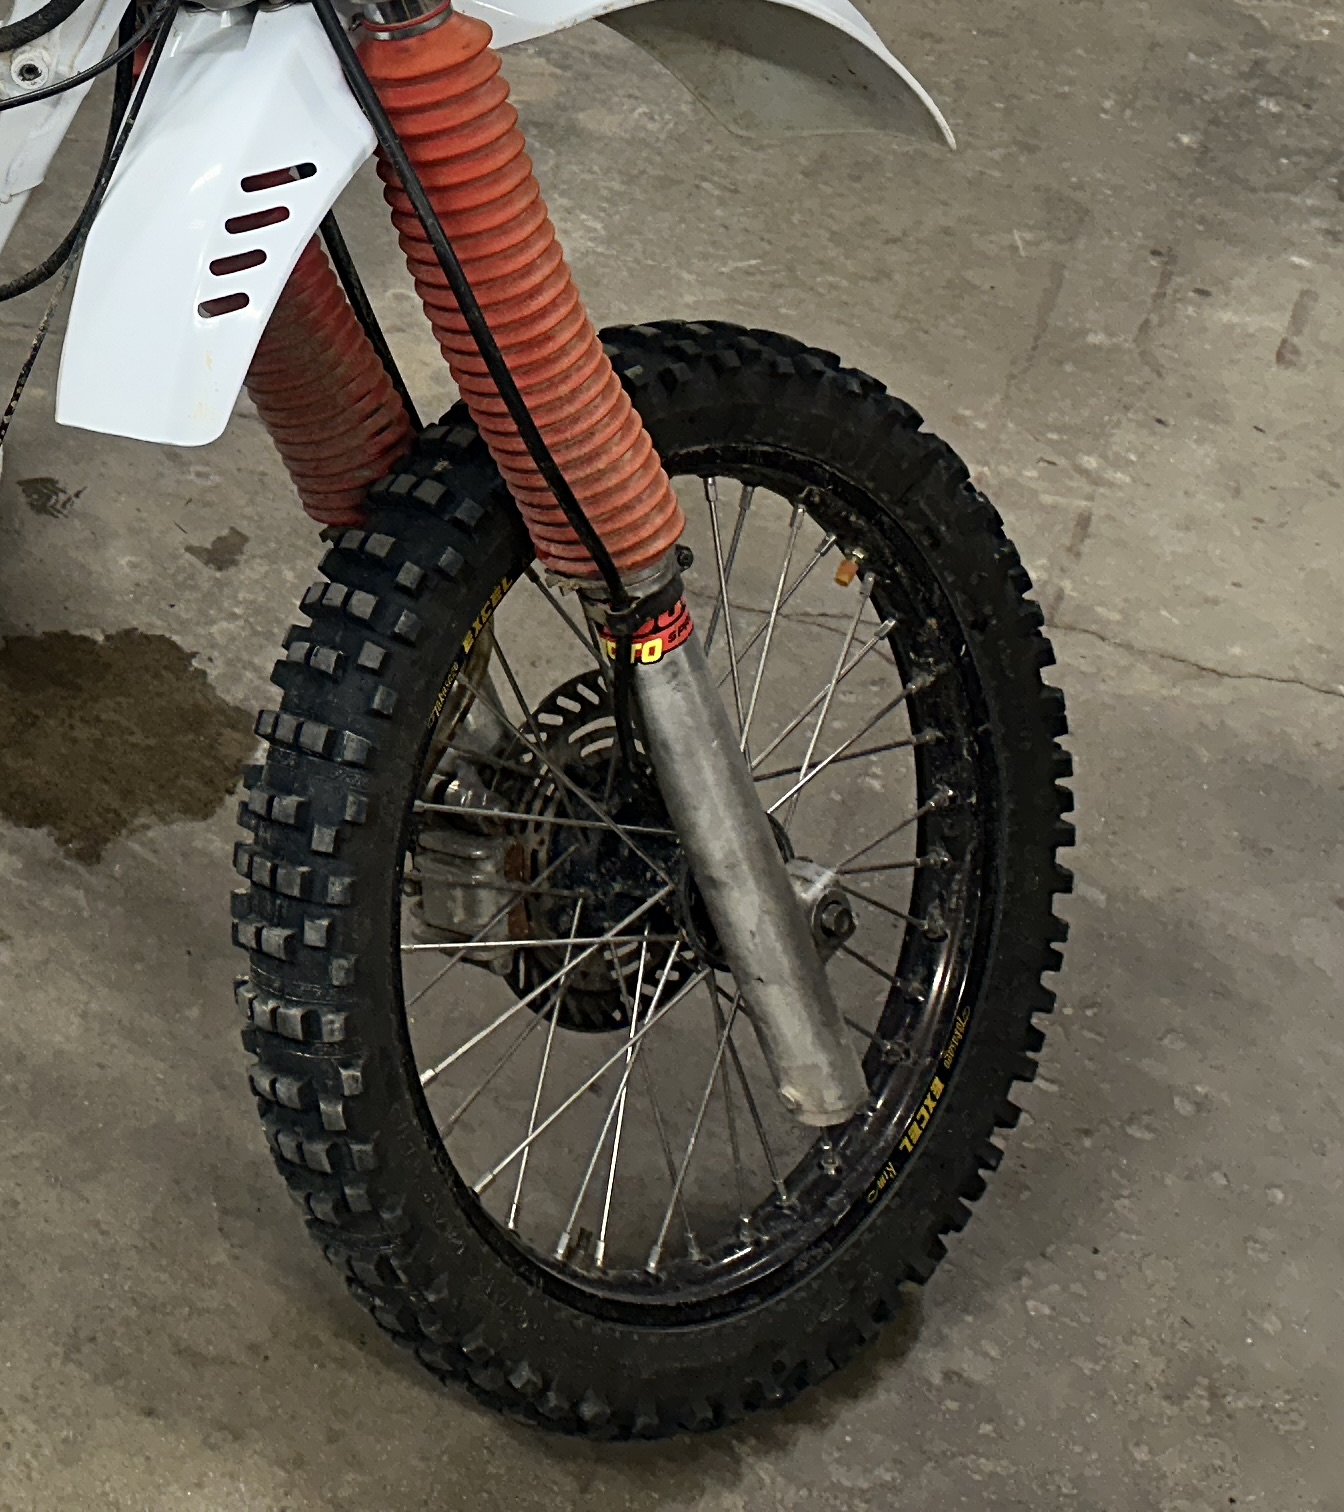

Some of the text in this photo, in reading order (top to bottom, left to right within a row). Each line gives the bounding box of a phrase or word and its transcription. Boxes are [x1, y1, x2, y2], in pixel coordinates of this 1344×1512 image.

[463, 576, 512, 654] EXCEL
[600, 637, 663, 664] OTO
[899, 1076, 945, 1153] EXCEL
